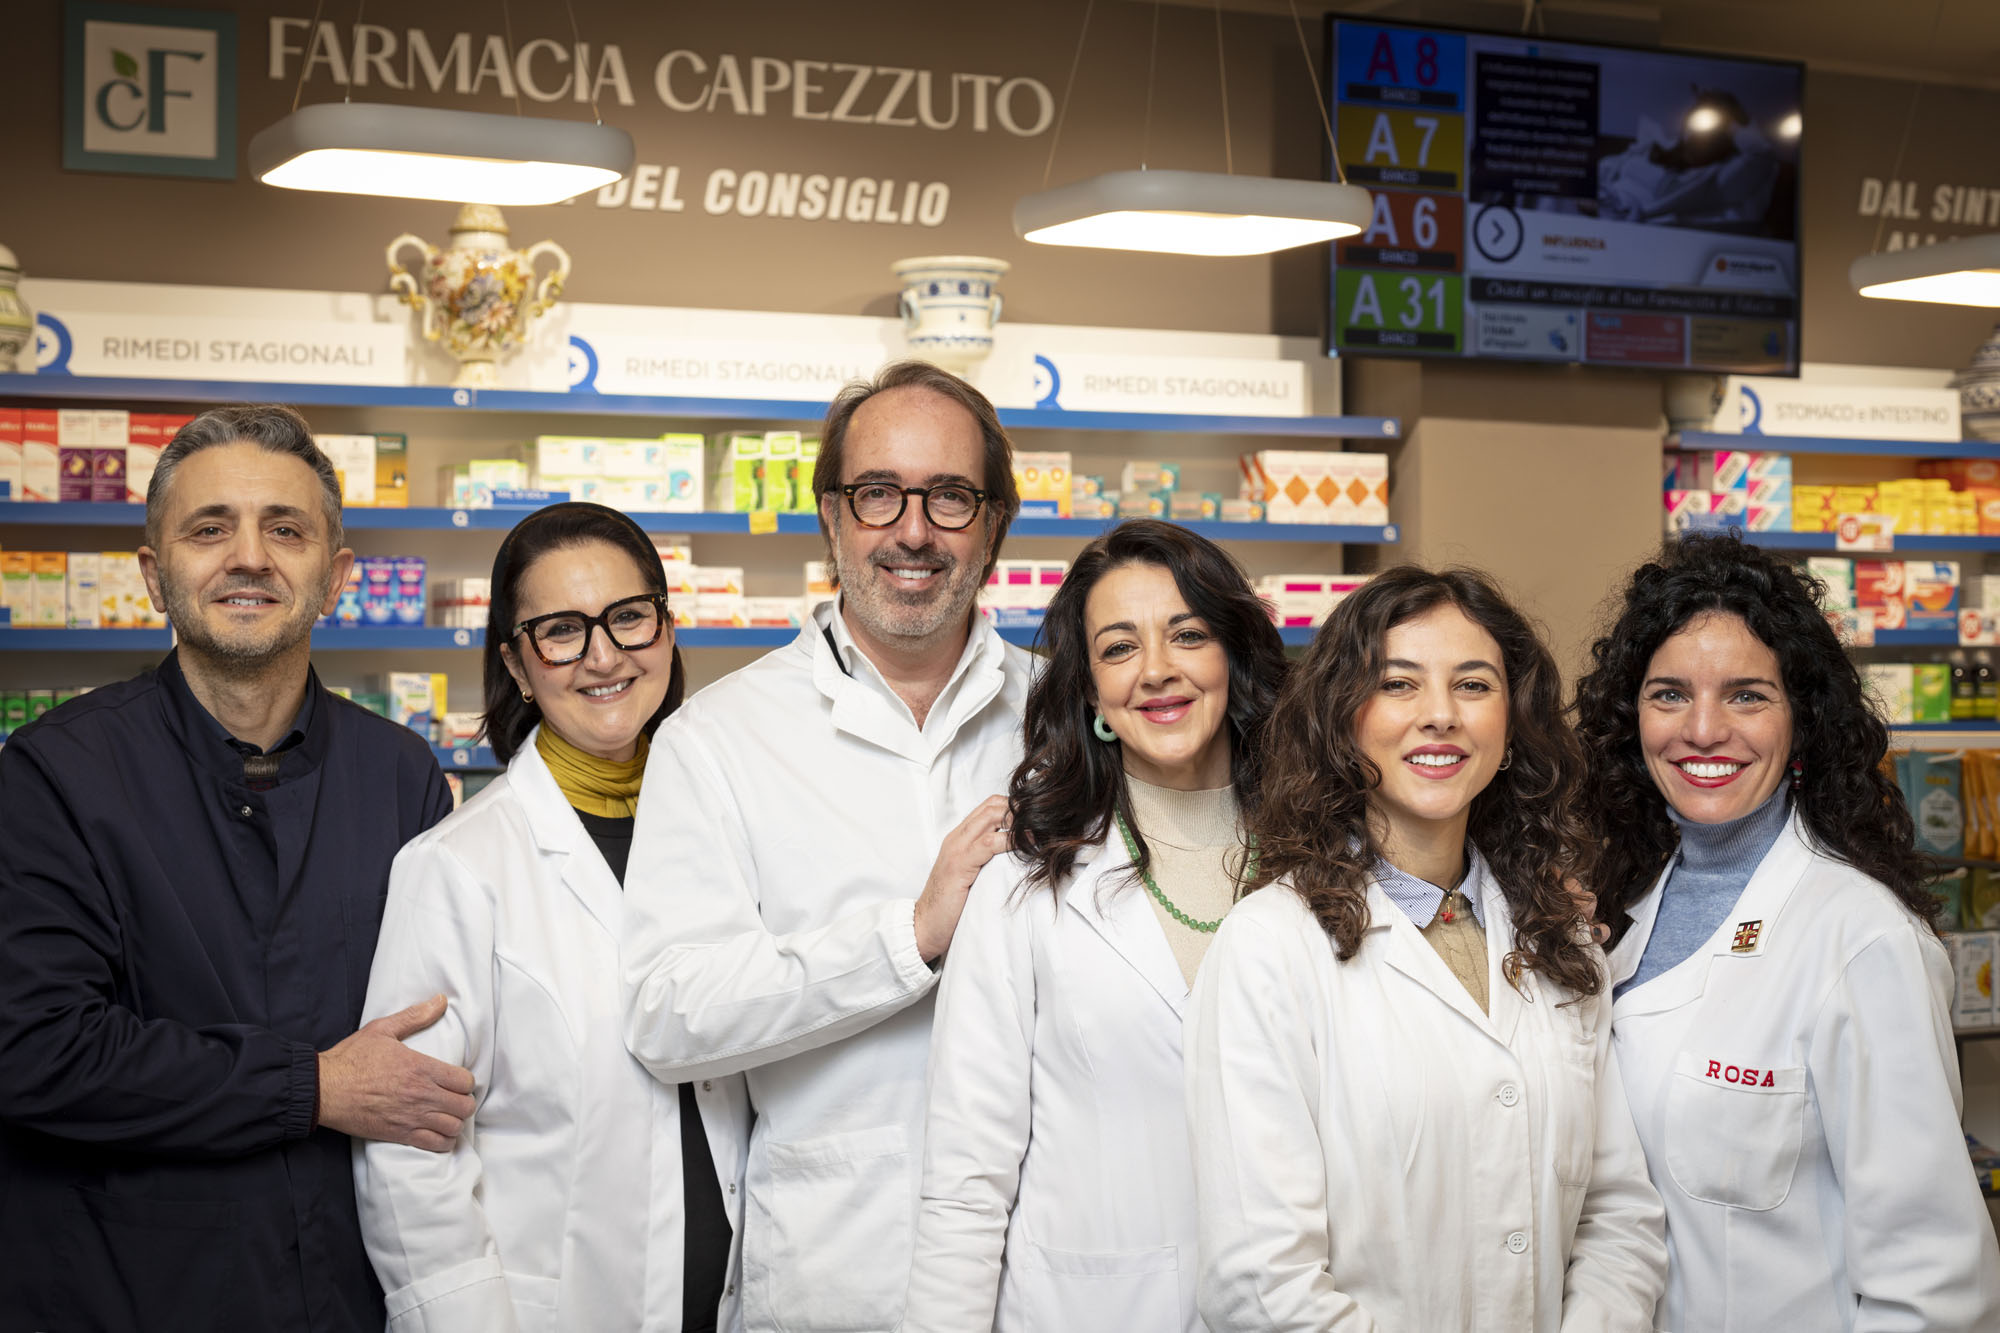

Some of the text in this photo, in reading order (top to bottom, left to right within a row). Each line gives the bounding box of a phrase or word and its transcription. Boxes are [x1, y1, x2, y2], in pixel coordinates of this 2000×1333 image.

[268, 16, 1055, 137] FARMACIA CAPEZZUTO
[1367, 31, 1439, 87] A 8
[1363, 112, 1400, 166] A
[1412, 116, 1440, 168] 7
[596, 163, 949, 228] DEL CONSIGLIO
[1857, 176, 1921, 221] DAL
[1362, 192, 1439, 250] A 6
[1348, 273, 1385, 327] A
[1398, 276, 1446, 331] 31
[102, 336, 375, 366] RIMEDI STAGIONALI
[625, 356, 711, 379] RIMEDI
[1084, 374, 1290, 400] RIMEDI STAGIONALI
[1775, 402, 1854, 422] STOMACO
[1871, 405, 1949, 425] INTESTINO
[1706, 1060, 1775, 1087] ROSA
